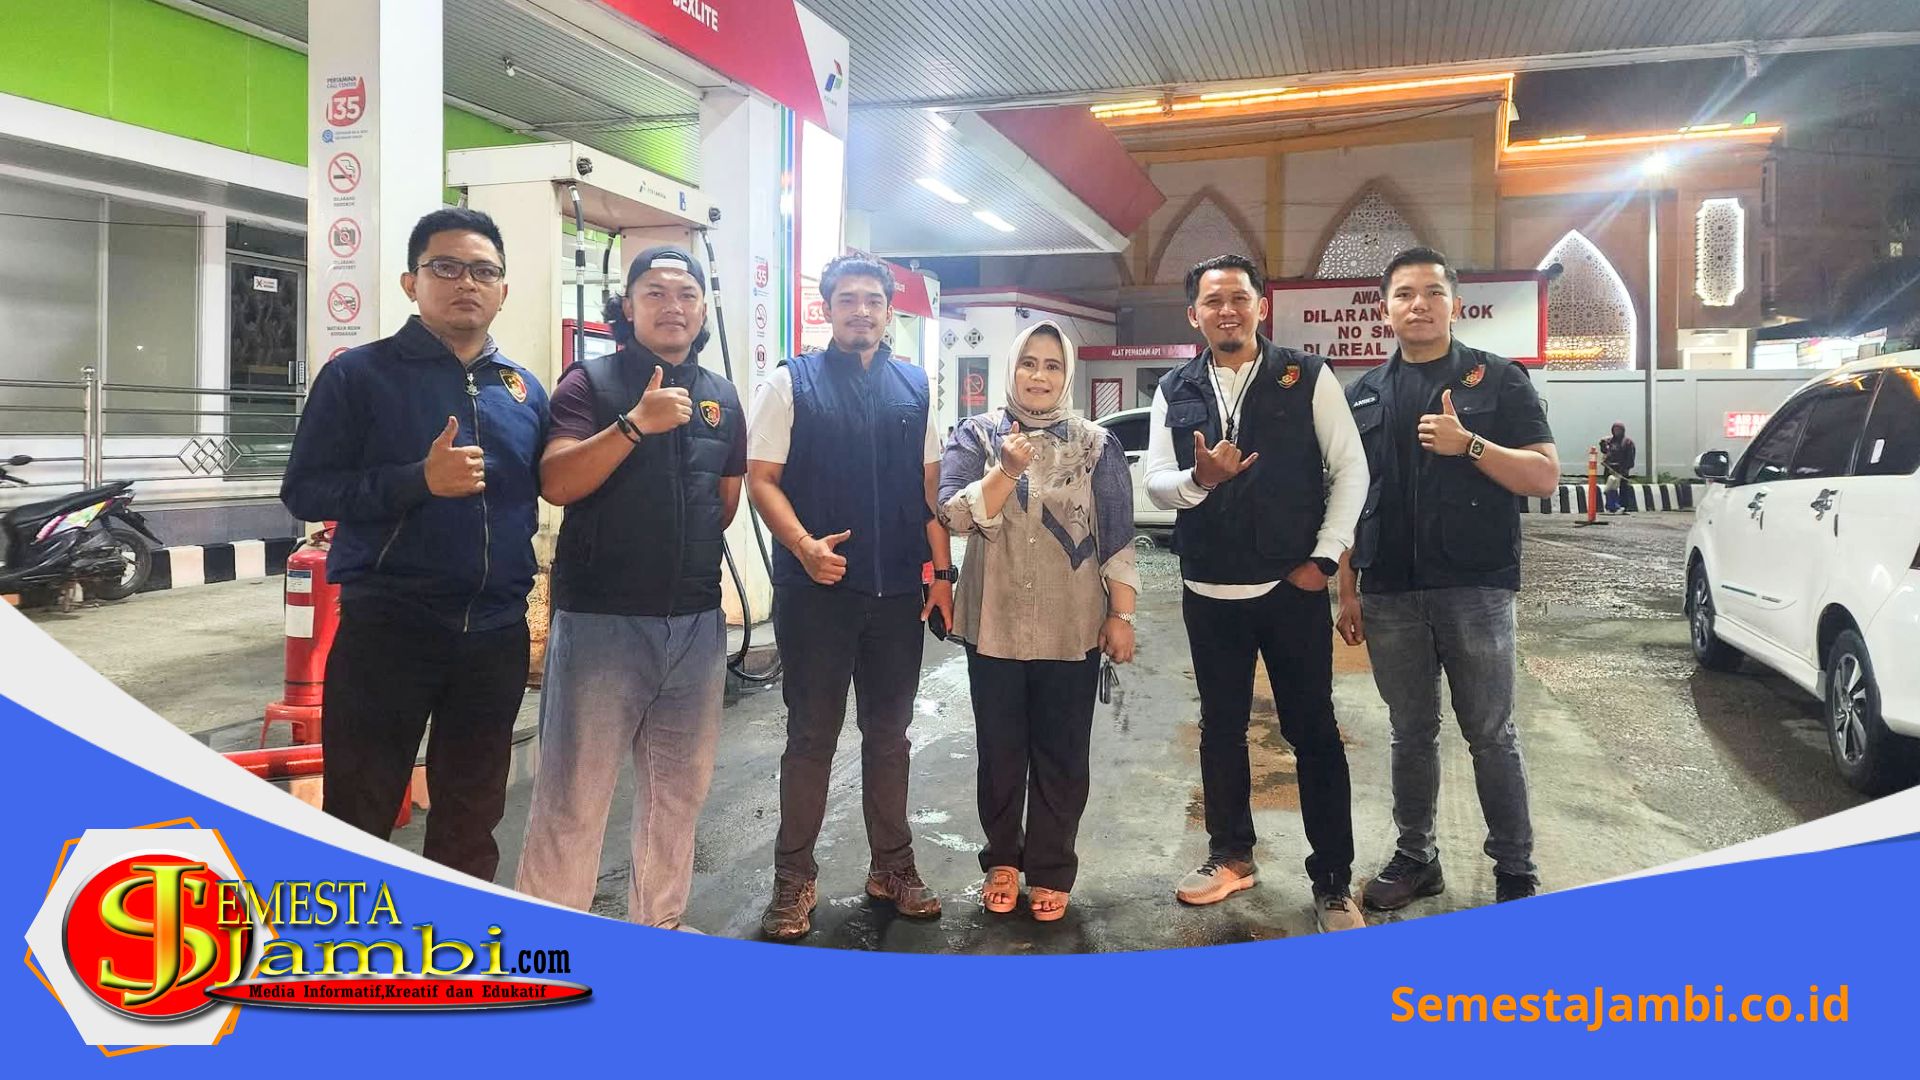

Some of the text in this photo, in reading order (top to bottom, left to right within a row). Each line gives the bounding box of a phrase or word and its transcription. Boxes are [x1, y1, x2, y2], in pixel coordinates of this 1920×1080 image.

[1352, 290, 1381, 304] AWA
[1303, 304, 1493, 323] DILARAN KOK
[1338, 325, 1395, 339] NO SM
[1327, 342, 1387, 356] AREAL
